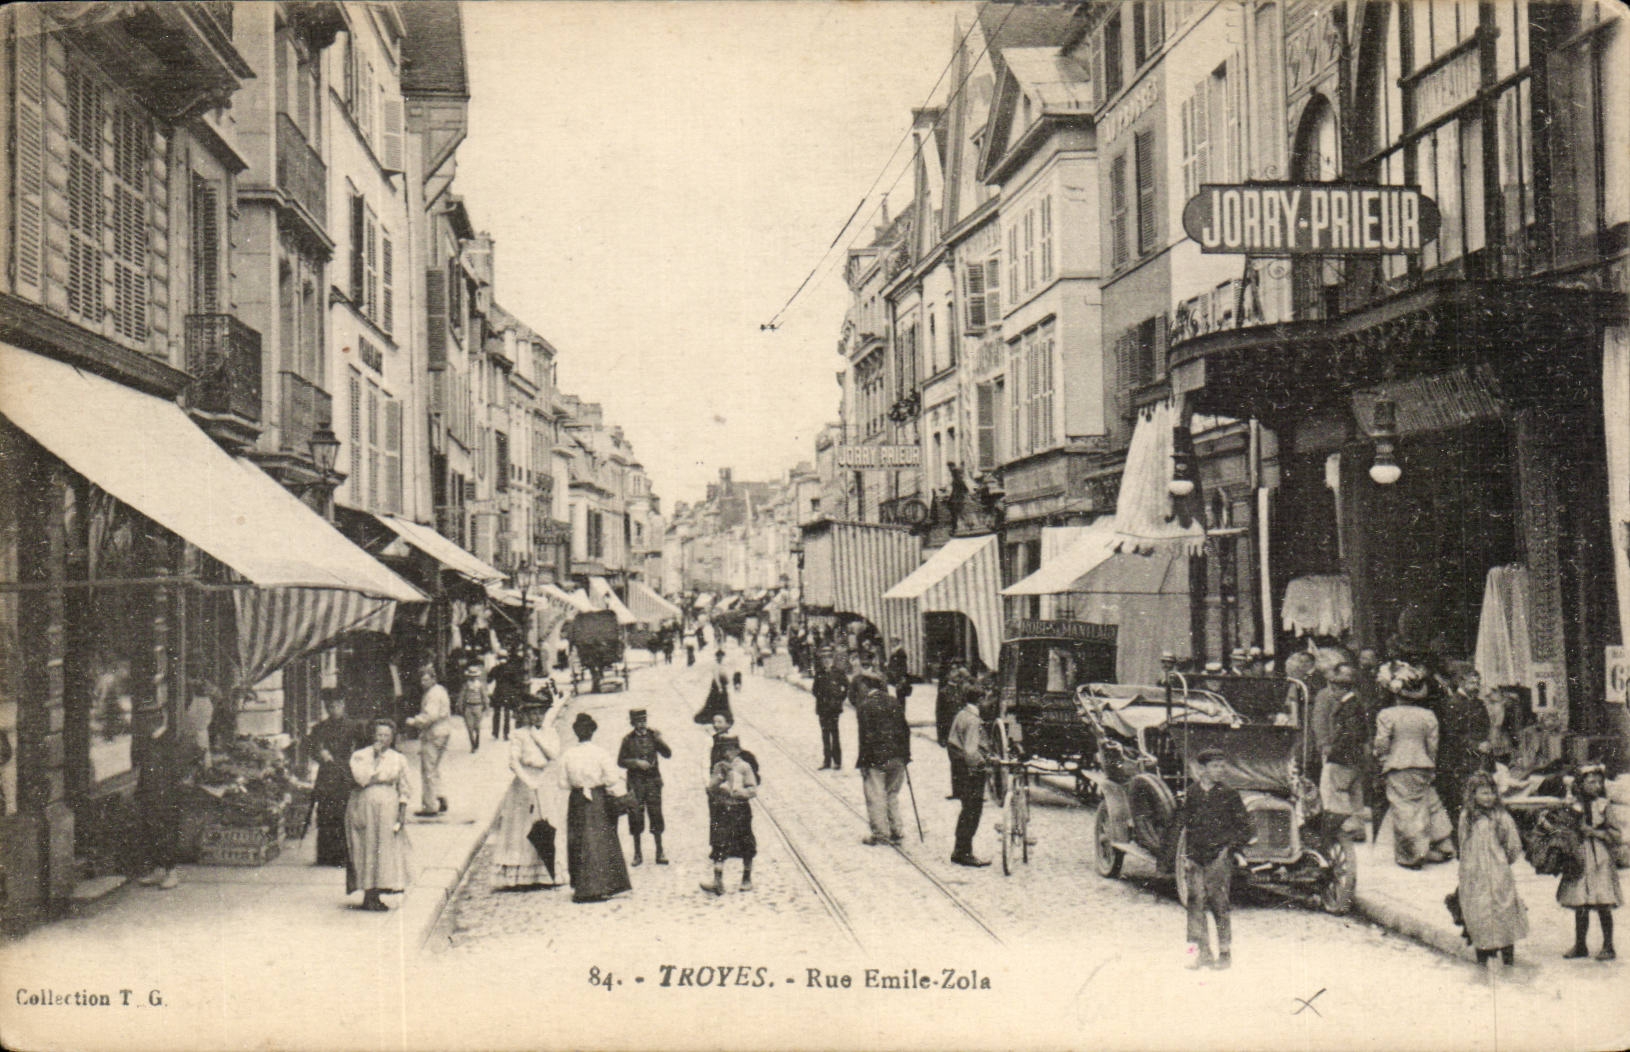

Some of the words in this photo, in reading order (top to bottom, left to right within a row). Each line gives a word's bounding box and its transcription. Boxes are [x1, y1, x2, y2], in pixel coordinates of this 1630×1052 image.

[1202, 190, 1420, 249] JORRY-PRIEUR
[838, 446, 876, 465] JORRY
[880, 446, 919, 464] PRIEUR
